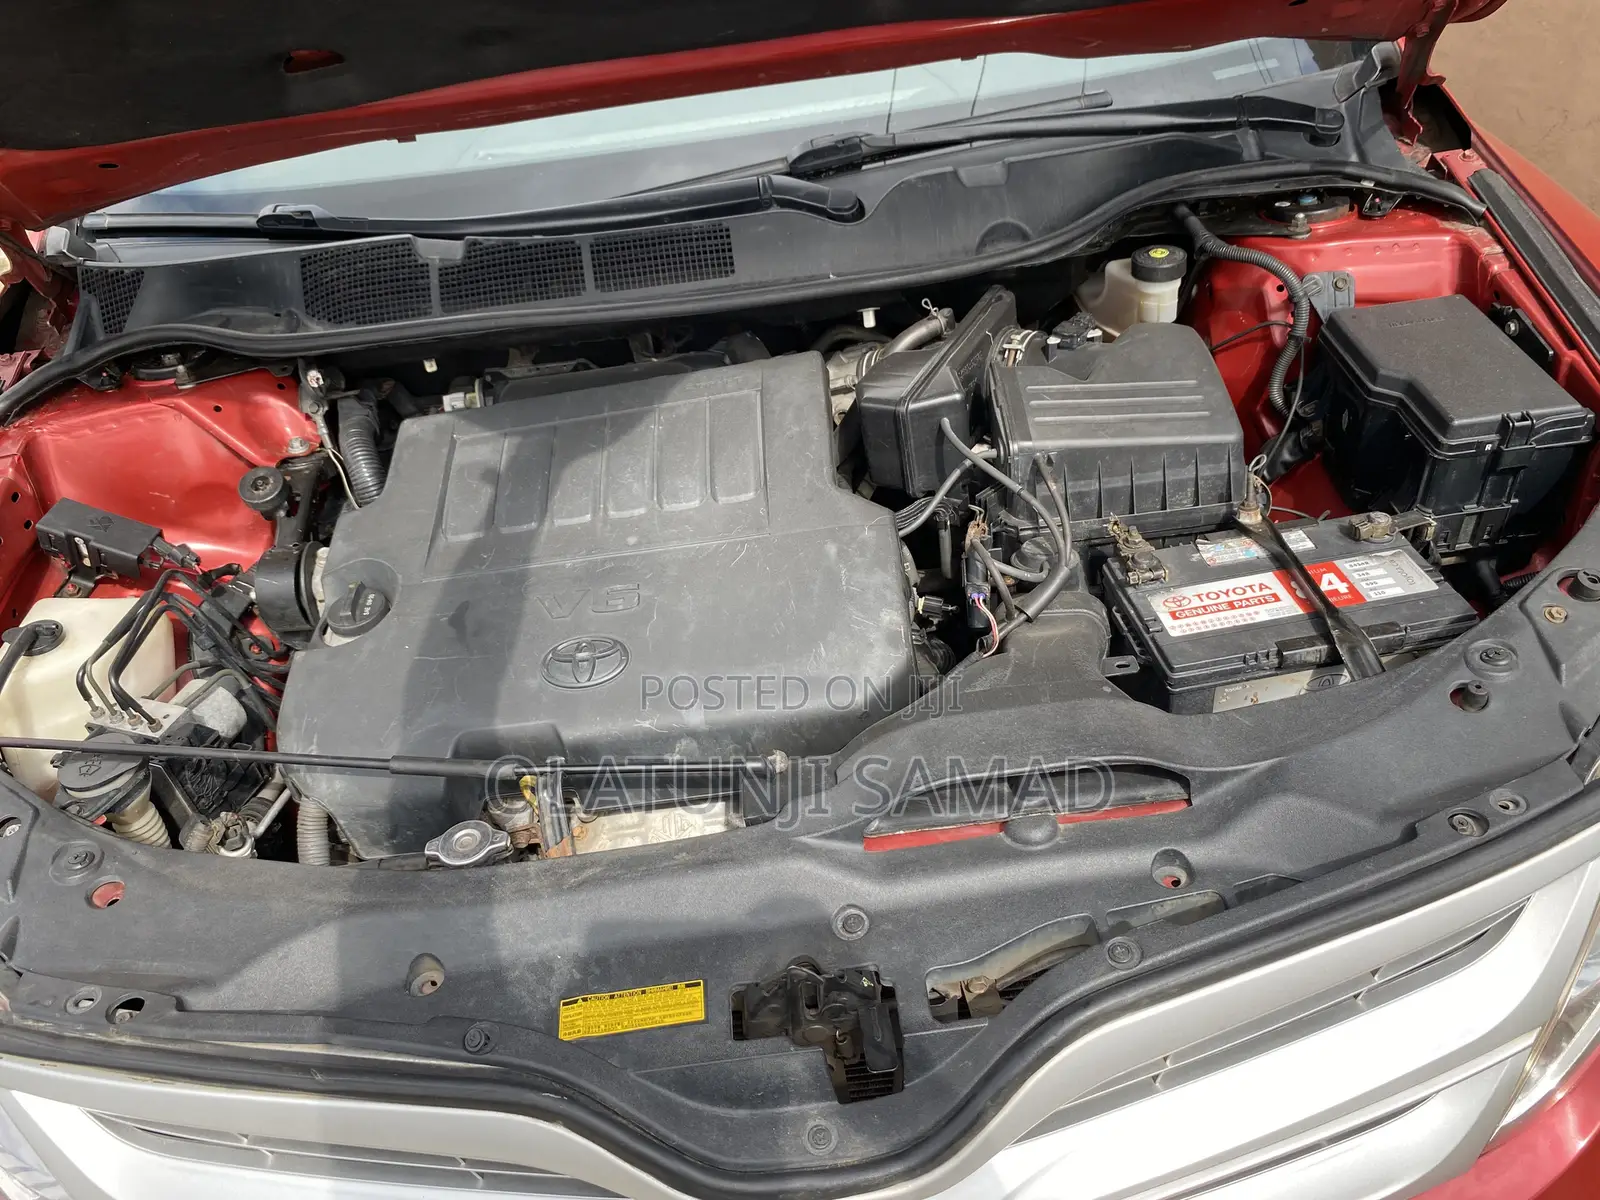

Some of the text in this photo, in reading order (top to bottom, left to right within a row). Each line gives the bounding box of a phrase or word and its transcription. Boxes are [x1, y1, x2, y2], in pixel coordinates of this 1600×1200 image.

[534, 584, 640, 620] V6
[1193, 582, 1273, 603] TOYOTA
[1175, 595, 1276, 619] GENUINE PARTS
